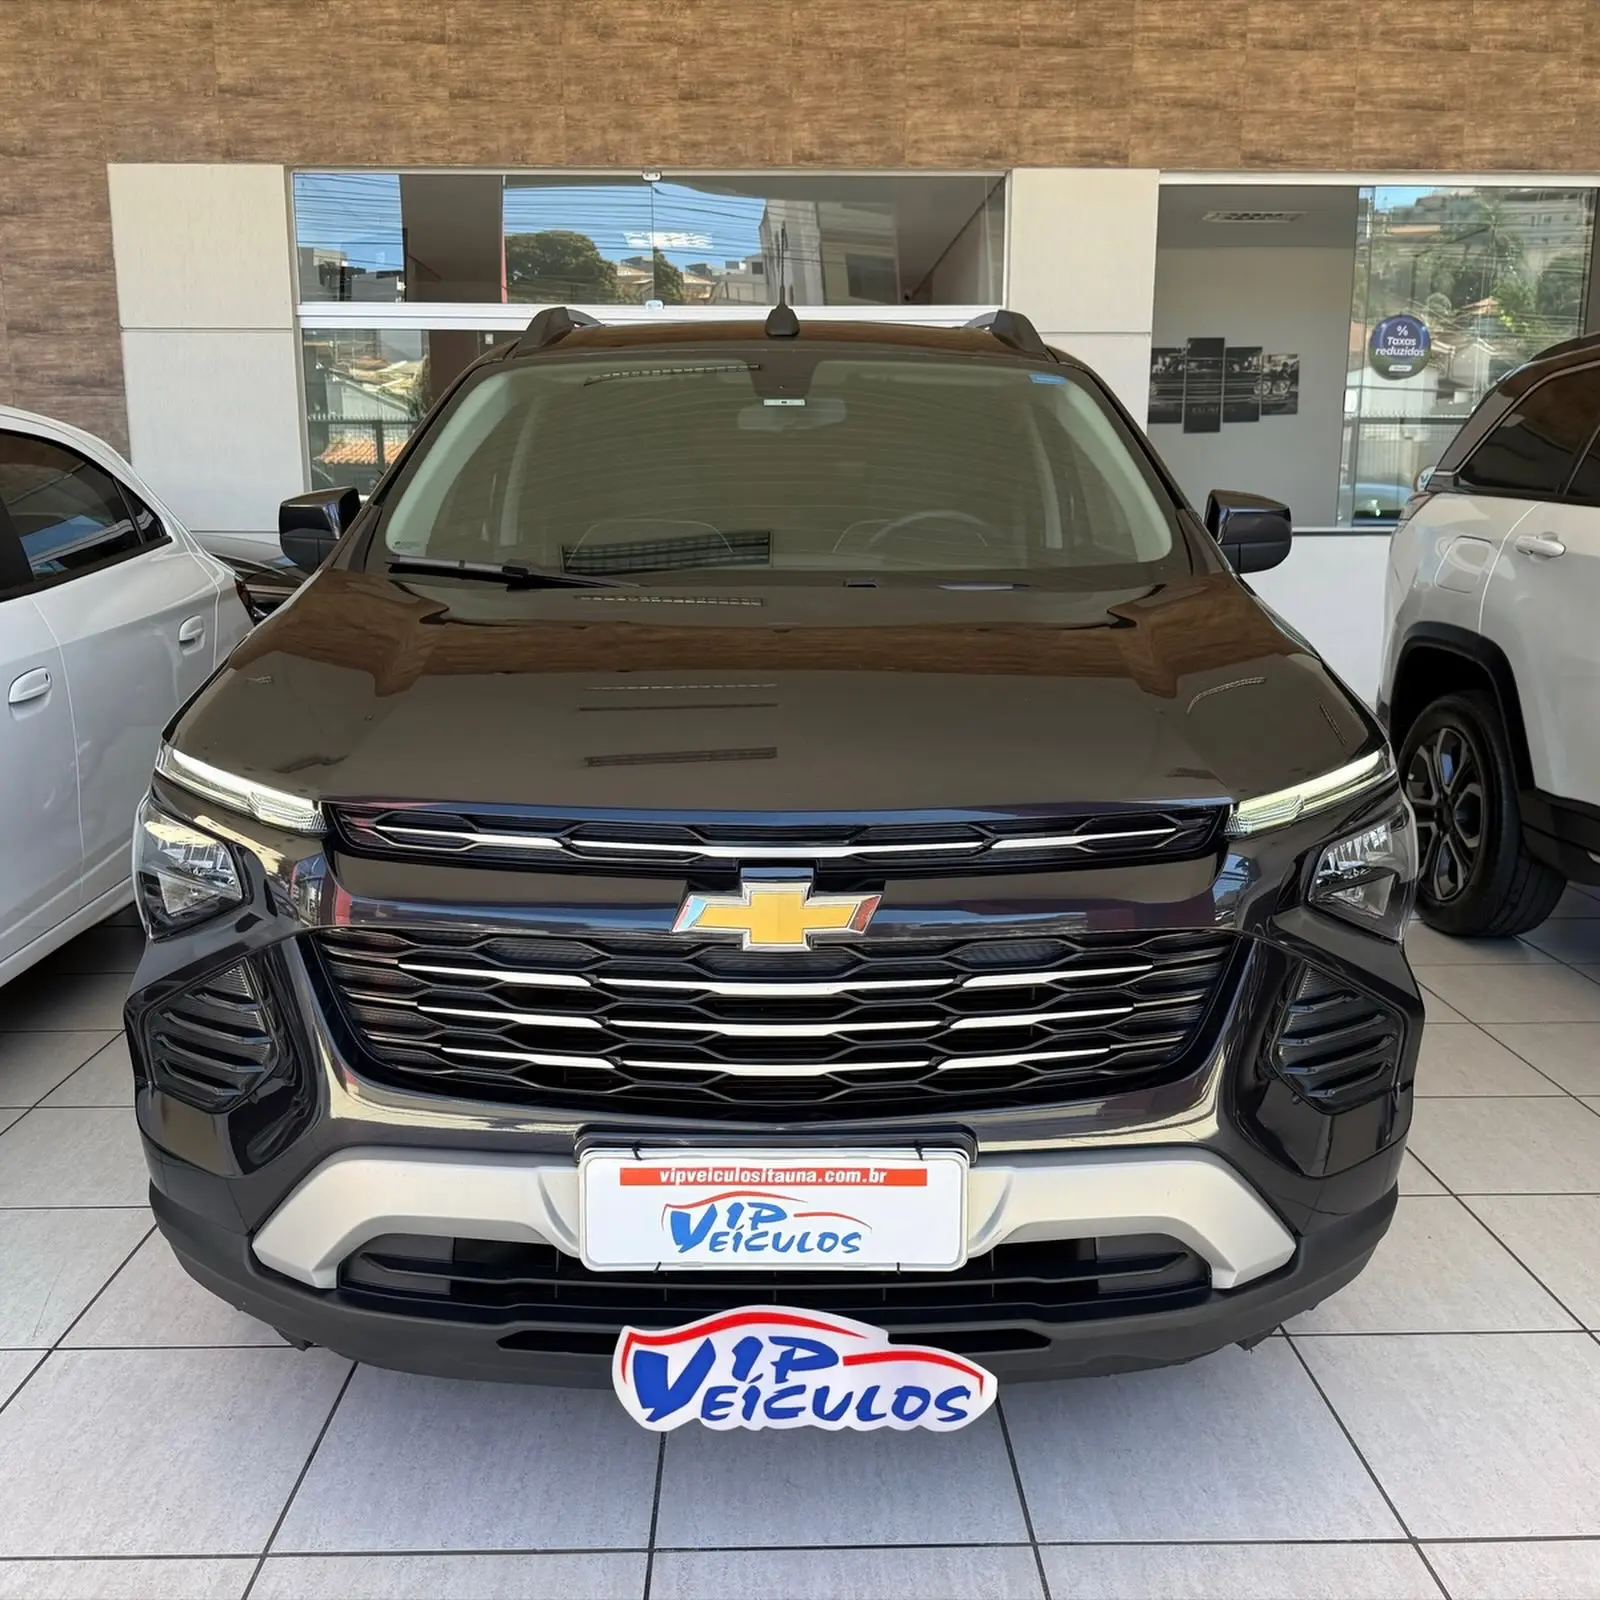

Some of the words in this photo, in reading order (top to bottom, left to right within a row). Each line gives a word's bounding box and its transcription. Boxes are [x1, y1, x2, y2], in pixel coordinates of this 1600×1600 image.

[1387, 336, 1417, 346] Taxas
[1375, 346, 1425, 357] reduzidas
[660, 1167, 888, 1185] vipveiculositauna.com.br
[671, 1202, 788, 1253] VIP
[632, 1335, 840, 1423] VIP
